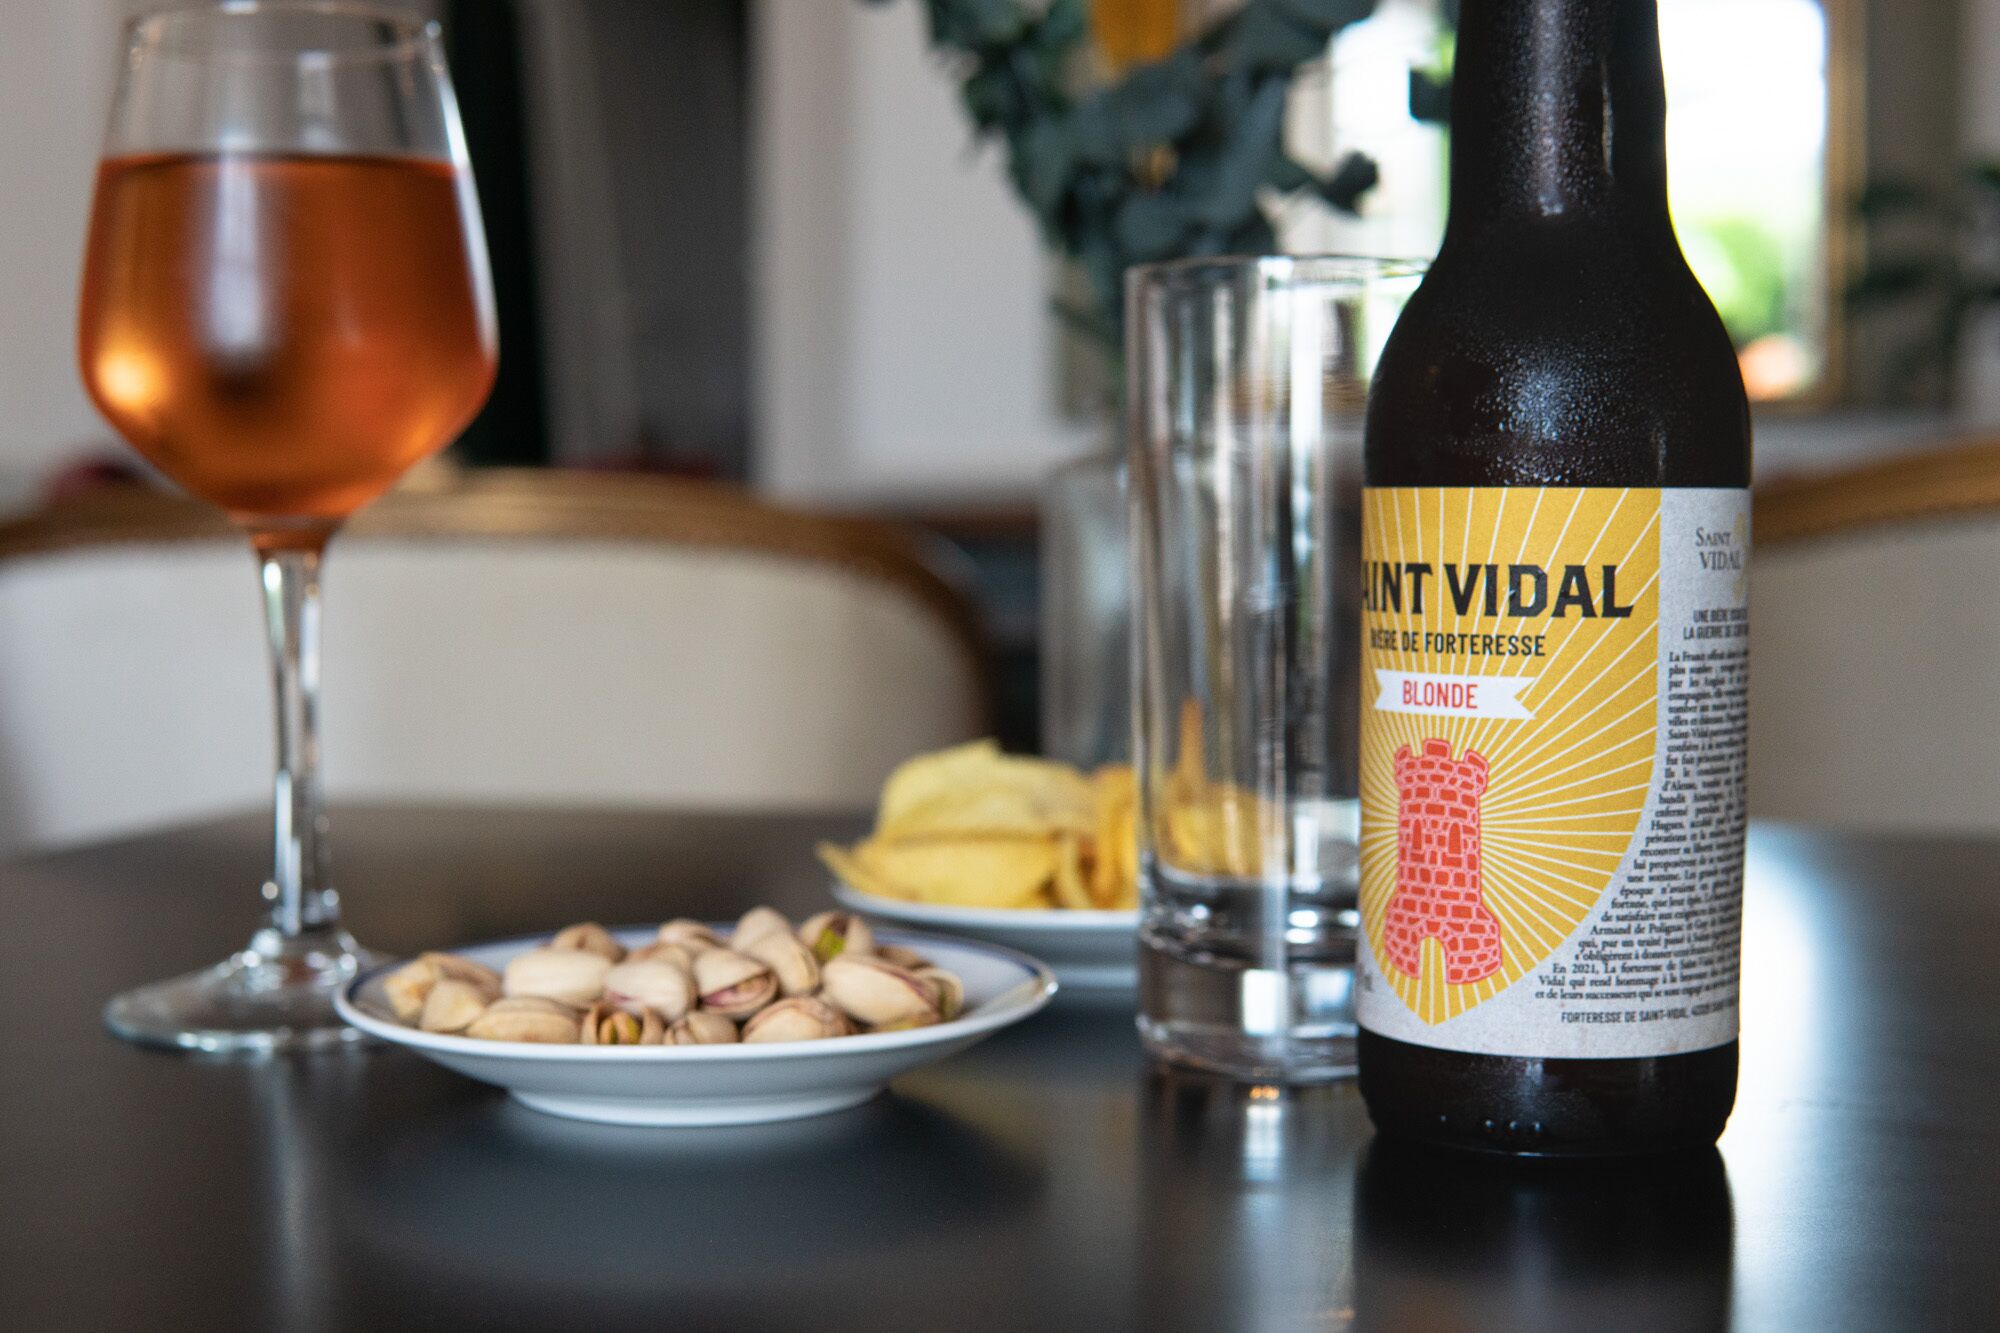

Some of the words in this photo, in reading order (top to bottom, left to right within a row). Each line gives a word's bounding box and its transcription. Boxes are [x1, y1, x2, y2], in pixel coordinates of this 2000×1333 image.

[1699, 549, 1742, 571] VIDAL
[1443, 563, 1635, 618] VIDAL
[1401, 630, 1421, 653] DE
[1424, 631, 1546, 657] FORTERESSE
[1403, 679, 1478, 709] BLONDE
[1600, 910, 1613, 922] de
[1589, 924, 1631, 936] Armand
[1634, 923, 1646, 935] de
[1601, 939, 1618, 951] par
[1552, 962, 1567, 974] En
[1571, 963, 1600, 975] 2021,
[1603, 961, 1617, 974] La
[1538, 975, 1566, 986] Vidal
[1568, 976, 1586, 990] qui
[1589, 975, 1613, 986] rend
[1534, 990, 1545, 999] et
[1546, 988, 1558, 1000] de
[1559, 987, 1584, 1000] leurs
[1560, 1010, 1622, 1024] FORTERESSE
[1624, 1010, 1637, 1023] DE
